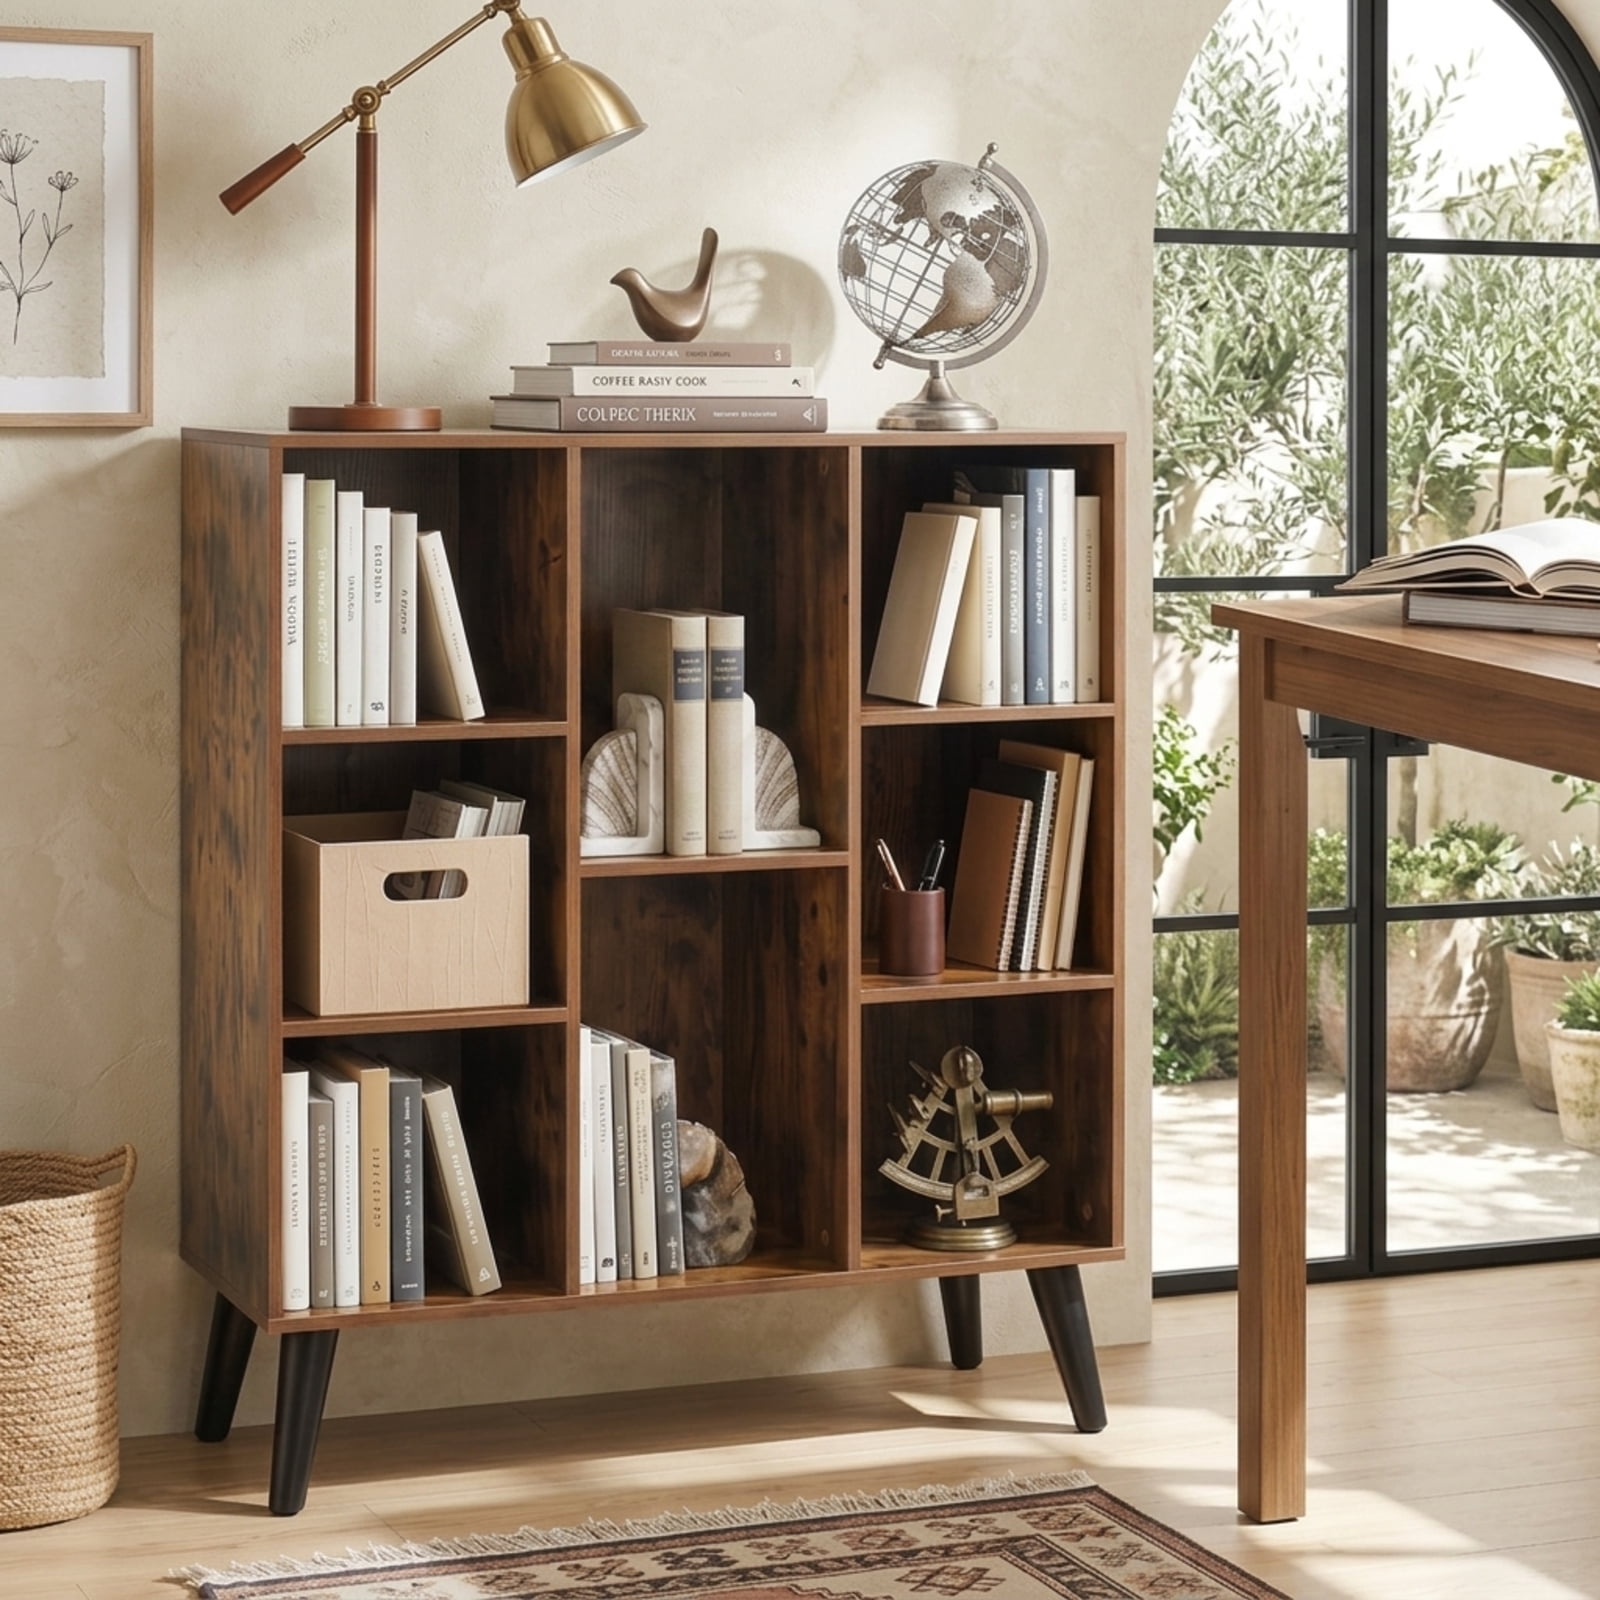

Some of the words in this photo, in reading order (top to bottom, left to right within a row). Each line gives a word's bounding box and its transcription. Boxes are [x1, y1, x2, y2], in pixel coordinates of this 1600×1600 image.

[592, 375, 635, 386] COFFEE
[675, 375, 707, 386] COOK
[643, 406, 697, 422] THERIX
